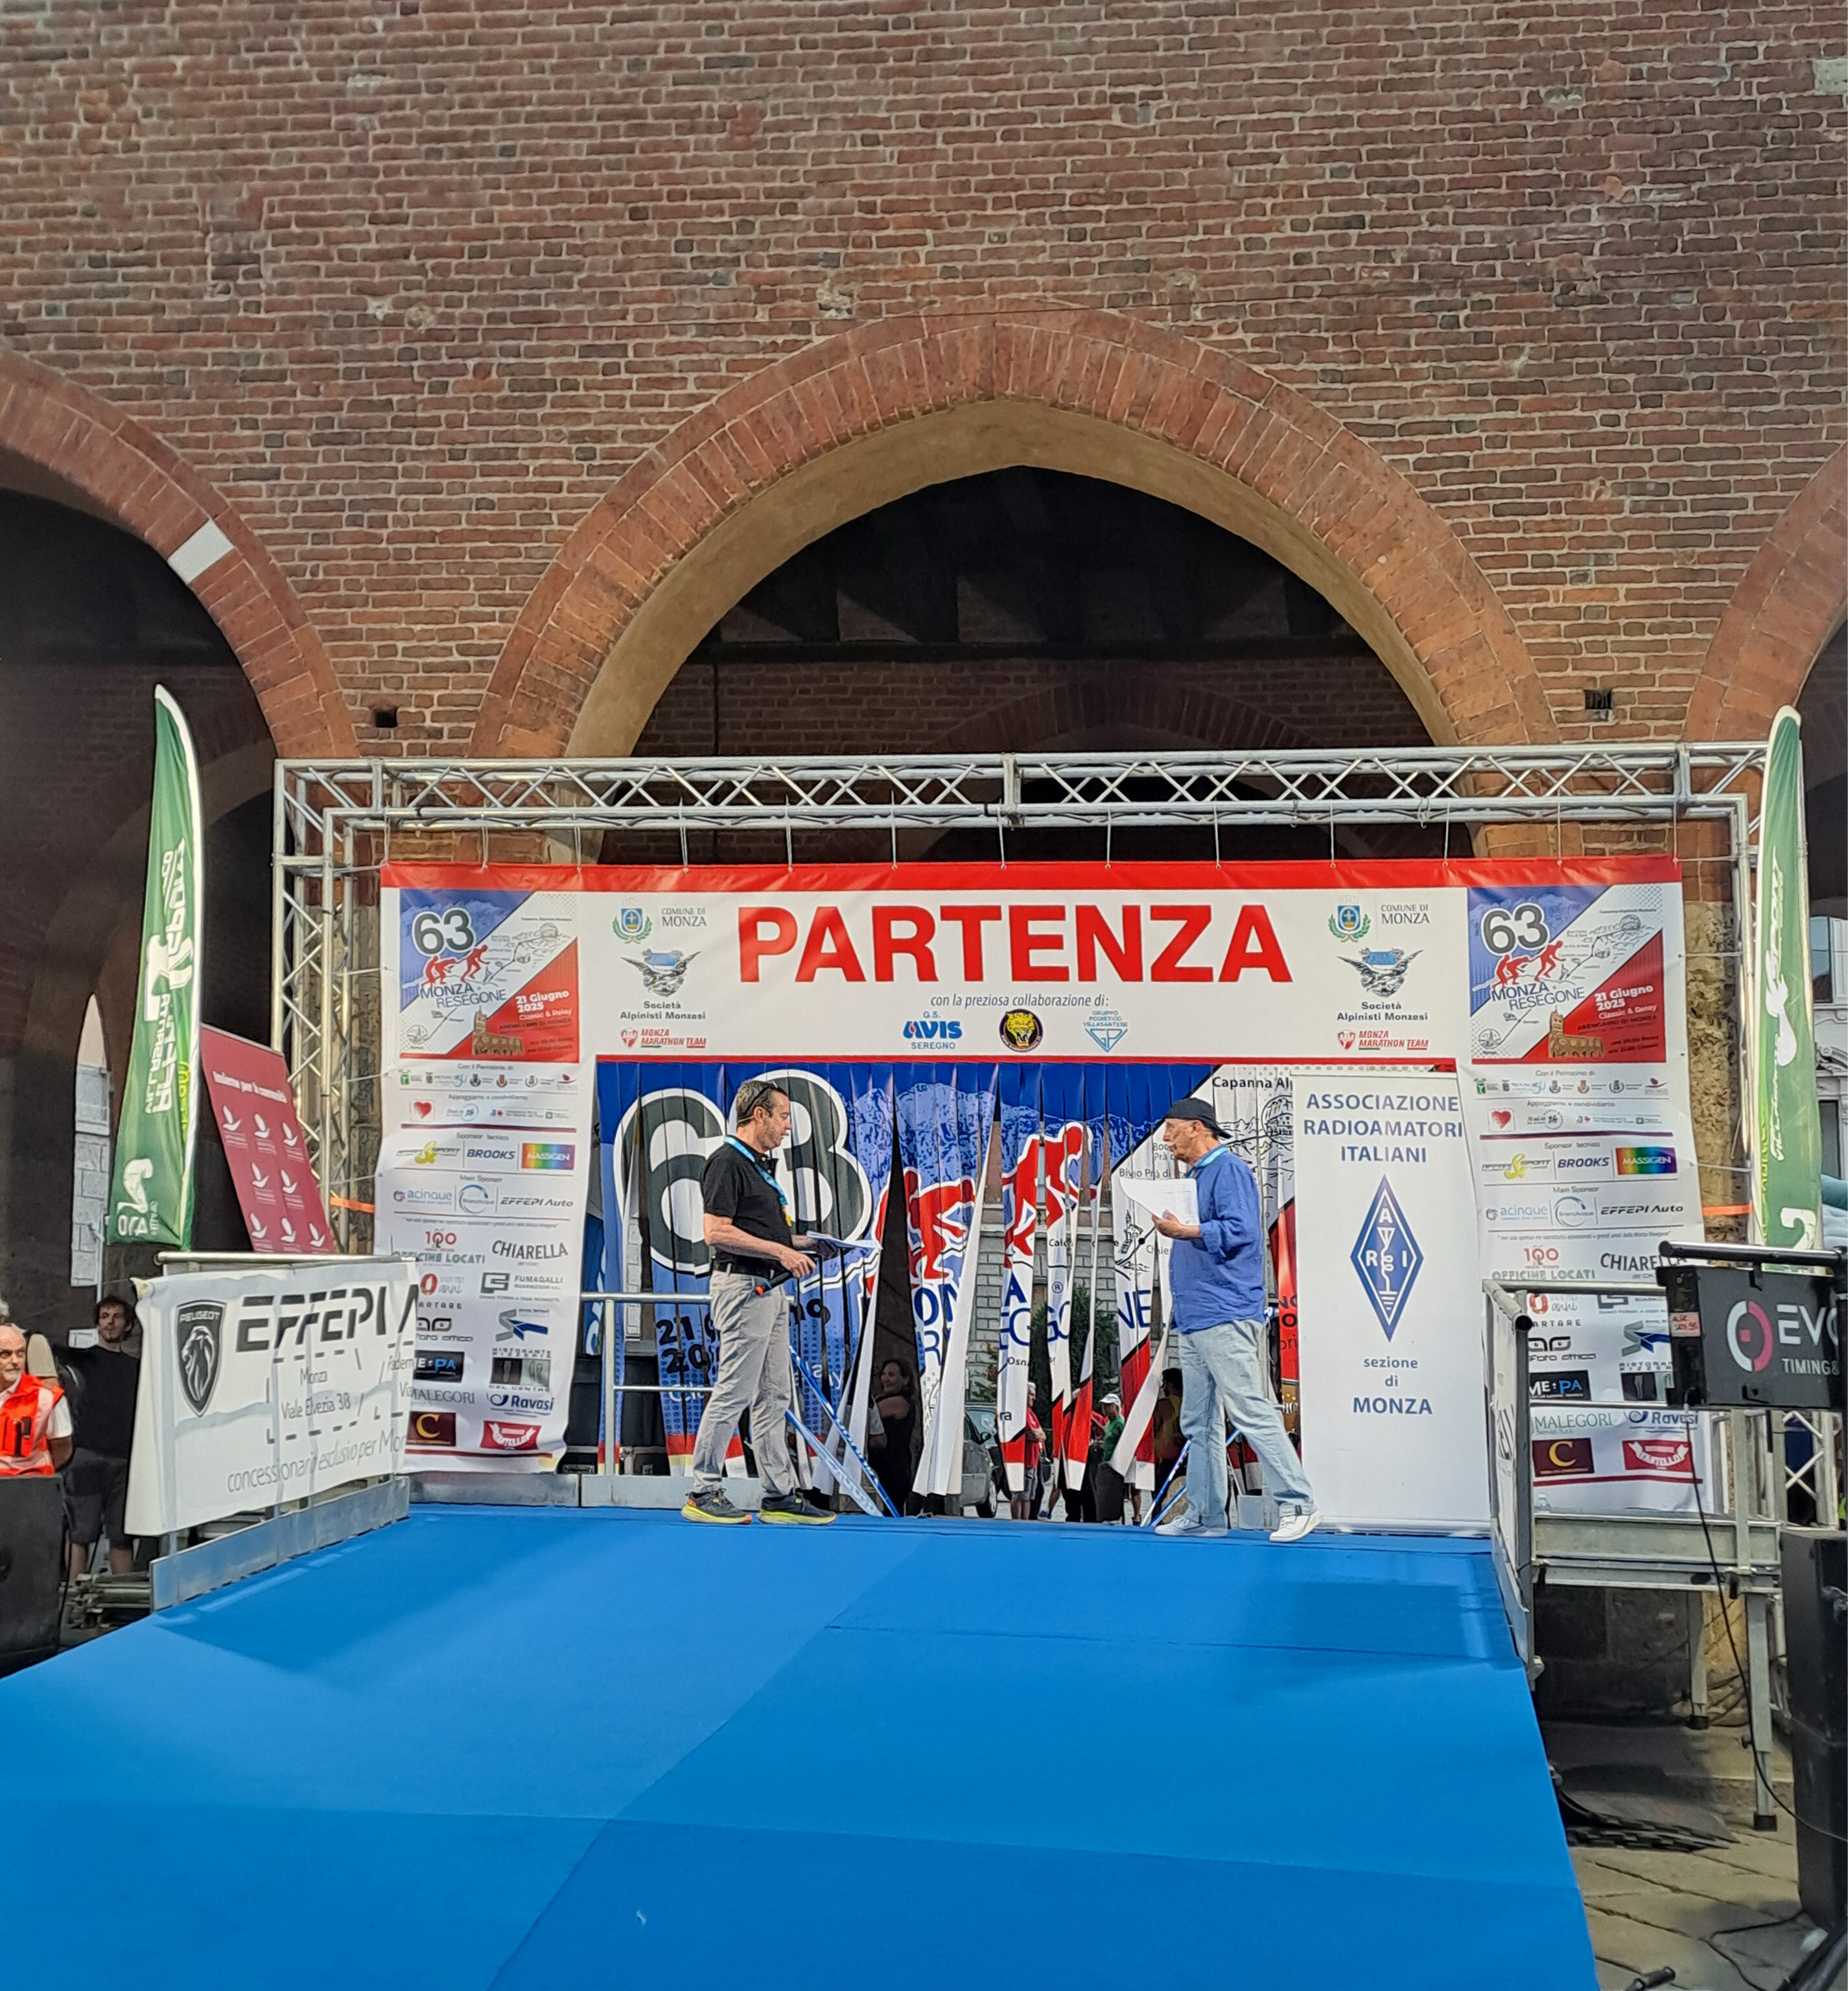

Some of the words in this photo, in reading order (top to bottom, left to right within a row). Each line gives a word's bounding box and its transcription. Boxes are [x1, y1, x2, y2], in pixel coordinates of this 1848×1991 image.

[662, 916, 707, 927] MONZA
[1381, 913, 1430, 924] MONZA
[414, 909, 475, 954] 63
[1483, 904, 1548, 953] 63
[738, 905, 1293, 983] PARTENZA
[420, 983, 474, 999] MONZA
[516, 996, 527, 1004] 21
[530, 990, 569, 1001] Giugno
[1491, 981, 1549, 1001] MONZA
[1595, 992, 1607, 1003] 21
[1609, 985, 1654, 999] Giugno
[436, 989, 507, 1008] RESEGONE
[931, 996, 949, 1006] con
[952, 994, 962, 1006] la
[965, 994, 1009, 1009] preziosa
[1012, 994, 1092, 1007] collaborazione
[1094, 994, 1109, 1007] di:
[1509, 986, 1585, 1011] RESEGONE
[1596, 998, 1625, 1011] 2025
[517, 1001, 544, 1012] 2025
[1361, 1001, 1401, 1010] Società
[620, 1012, 662, 1021] Alpinisti
[1337, 1012, 1381, 1022] Alpinisti
[1385, 1012, 1428, 1021] Monzesi
[903, 1020, 963, 1039] AVIS
[686, 1037, 707, 1045] TEAM
[1213, 1077, 1272, 1089] Capanna
[1306, 1093, 1459, 1112] ASSOCIAZIONE
[1304, 1119, 1463, 1138] RADIOAMATORI
[467, 1149, 516, 1159] BROOKS
[527, 1152, 570, 1161] MASSIGEN
[1341, 1145, 1427, 1163] ITALIANI
[1622, 1156, 1671, 1165] MASSIGEN
[1558, 1157, 1610, 1167] BROOKS
[500, 1197, 543, 1206] EFFEPI
[545, 1198, 574, 1207] Auto
[1501, 1204, 1547, 1216] acinque
[1601, 1205, 1650, 1215] EFFEPI
[492, 1239, 568, 1261] CHIARELLA
[446, 1253, 485, 1264] LOCATI
[1492, 1270, 1546, 1280] OFFICINE
[1551, 1269, 1595, 1279] LOCATI
[418, 1301, 462, 1310] ARTARE
[180, 1311, 220, 1323] PEUGEOT
[236, 1286, 387, 1353] EFFEPI
[1532, 1318, 1582, 1327] ARTARE
[1363, 1357, 1418, 1369] sezione
[300, 1368, 328, 1386] Monza
[1385, 1375, 1399, 1387] di
[281, 1399, 303, 1419] Viale
[336, 1393, 351, 1410] 38
[511, 1395, 555, 1410] Ravasi
[1353, 1397, 1433, 1415] MONZA
[1534, 1413, 1613, 1428] MALEGORI
[1652, 1411, 1698, 1425] Ravasi
